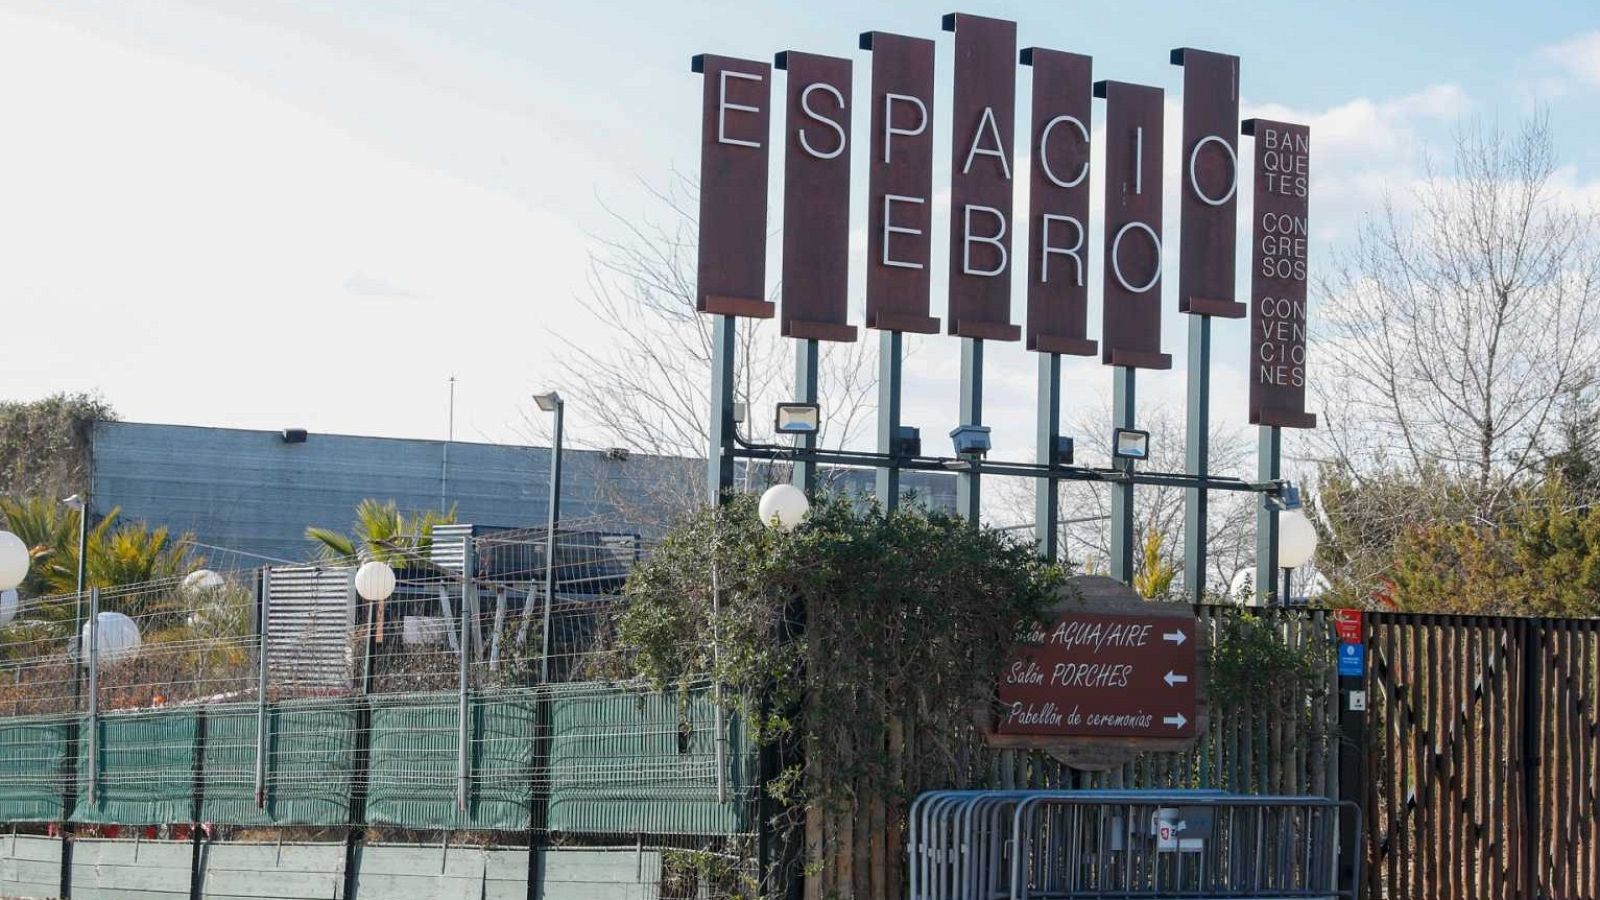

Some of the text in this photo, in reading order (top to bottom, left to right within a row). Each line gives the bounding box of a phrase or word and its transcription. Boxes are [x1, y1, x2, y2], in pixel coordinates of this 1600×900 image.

[718, 69, 1239, 206] ESPACIO
[1264, 129, 1309, 154] BAN
[1264, 150, 1308, 175] QUE
[1264, 172, 1308, 198] TES
[1262, 212, 1307, 236] CON
[883, 194, 1163, 294] EBRO
[1262, 235, 1306, 258] GRE
[1262, 256, 1306, 281] SOS
[1261, 297, 1306, 320] CON
[1261, 319, 1306, 342] VEN
[1260, 341, 1306, 365] CIO
[1260, 364, 1305, 388] NES
[1006, 660, 1133, 688] Salón PORCHES
[1007, 700, 1153, 729] Pabellón de ceremonias
